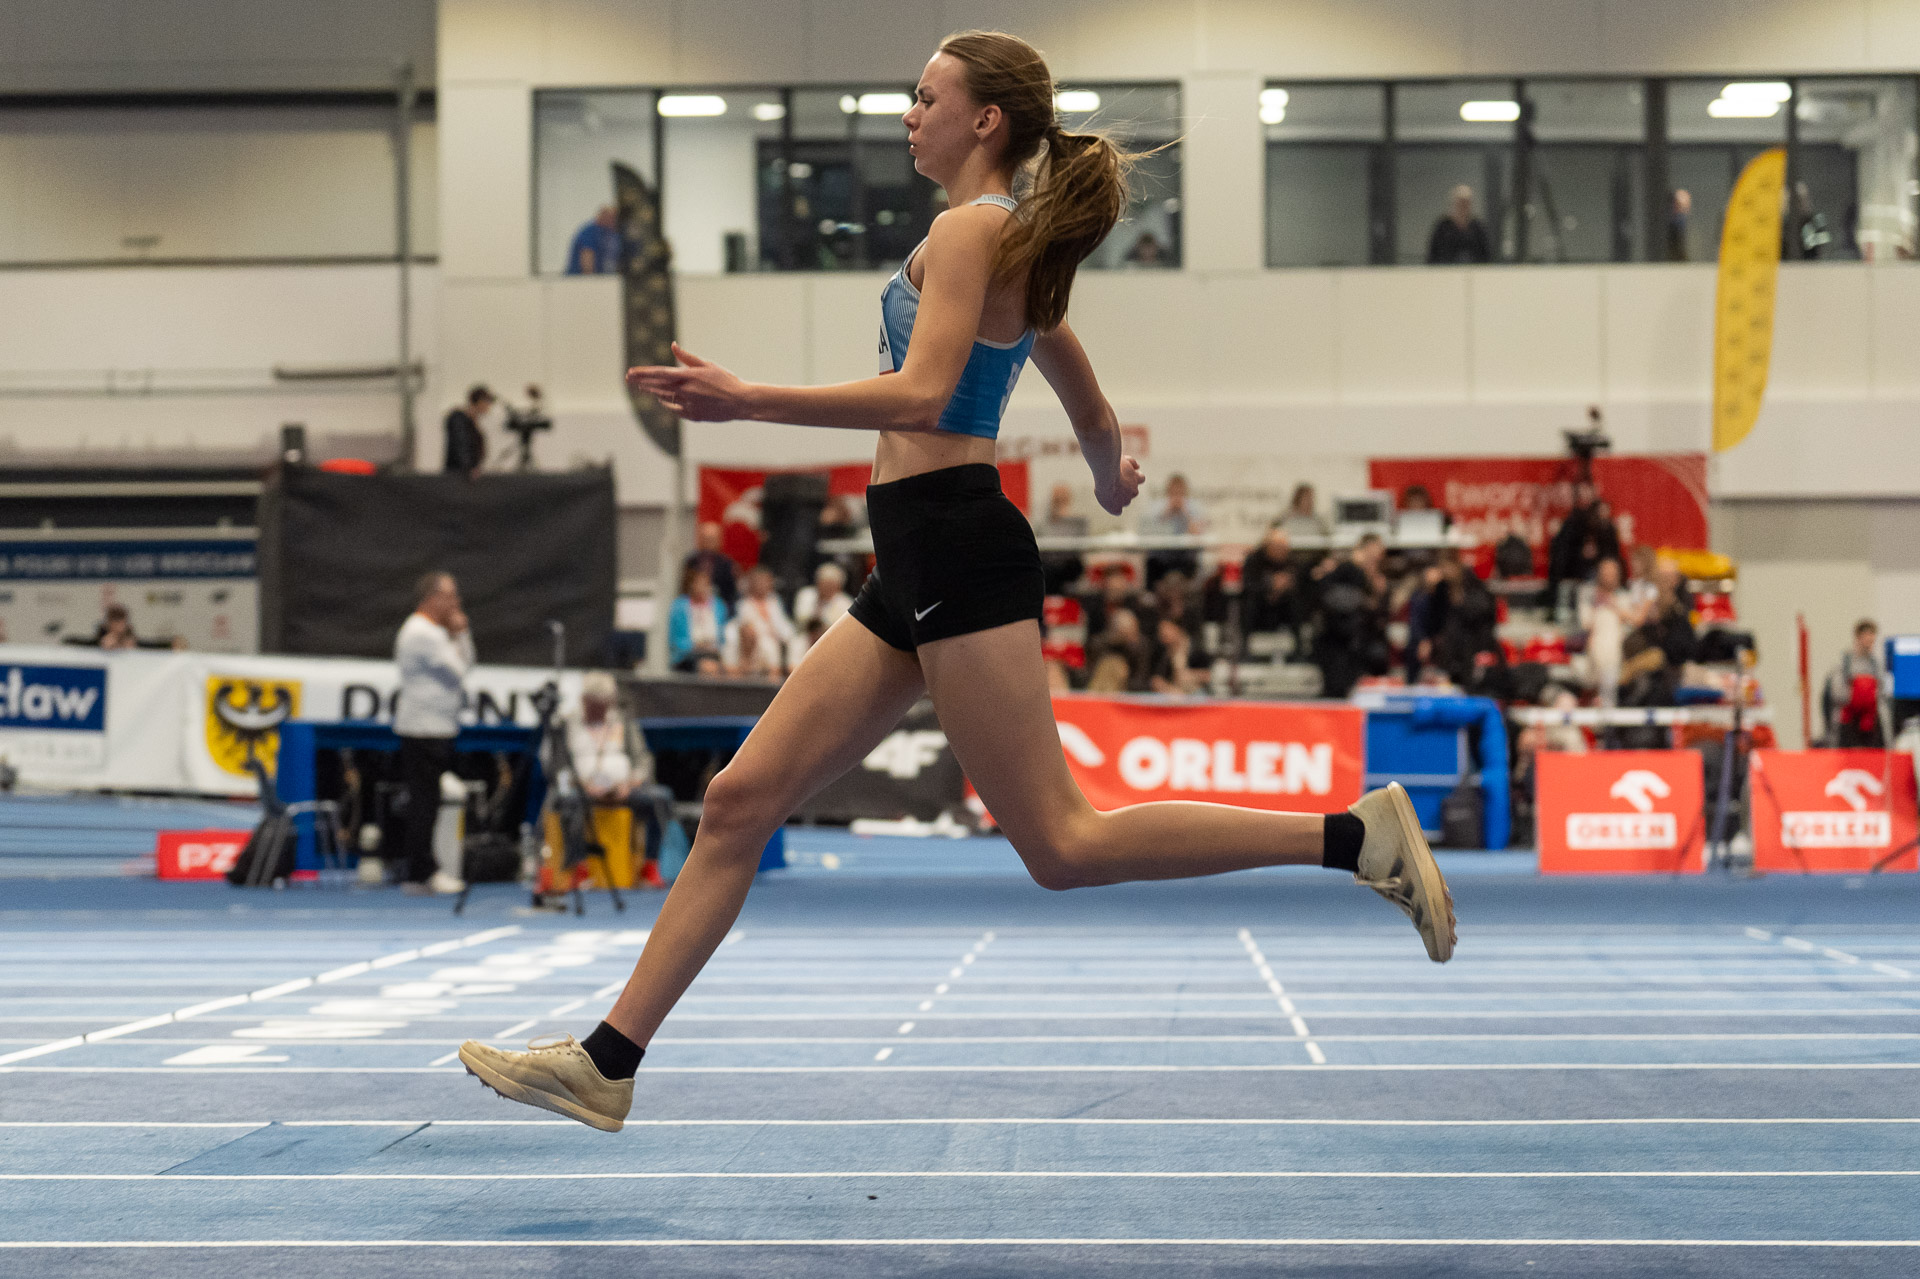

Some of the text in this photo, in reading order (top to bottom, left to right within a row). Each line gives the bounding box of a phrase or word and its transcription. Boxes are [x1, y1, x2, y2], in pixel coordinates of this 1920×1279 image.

[861, 730, 949, 779] 4F
[1118, 736, 1333, 795] ORLEN
[1576, 823, 1666, 841] ORLEN
[1787, 822, 1881, 840] ORLEN
